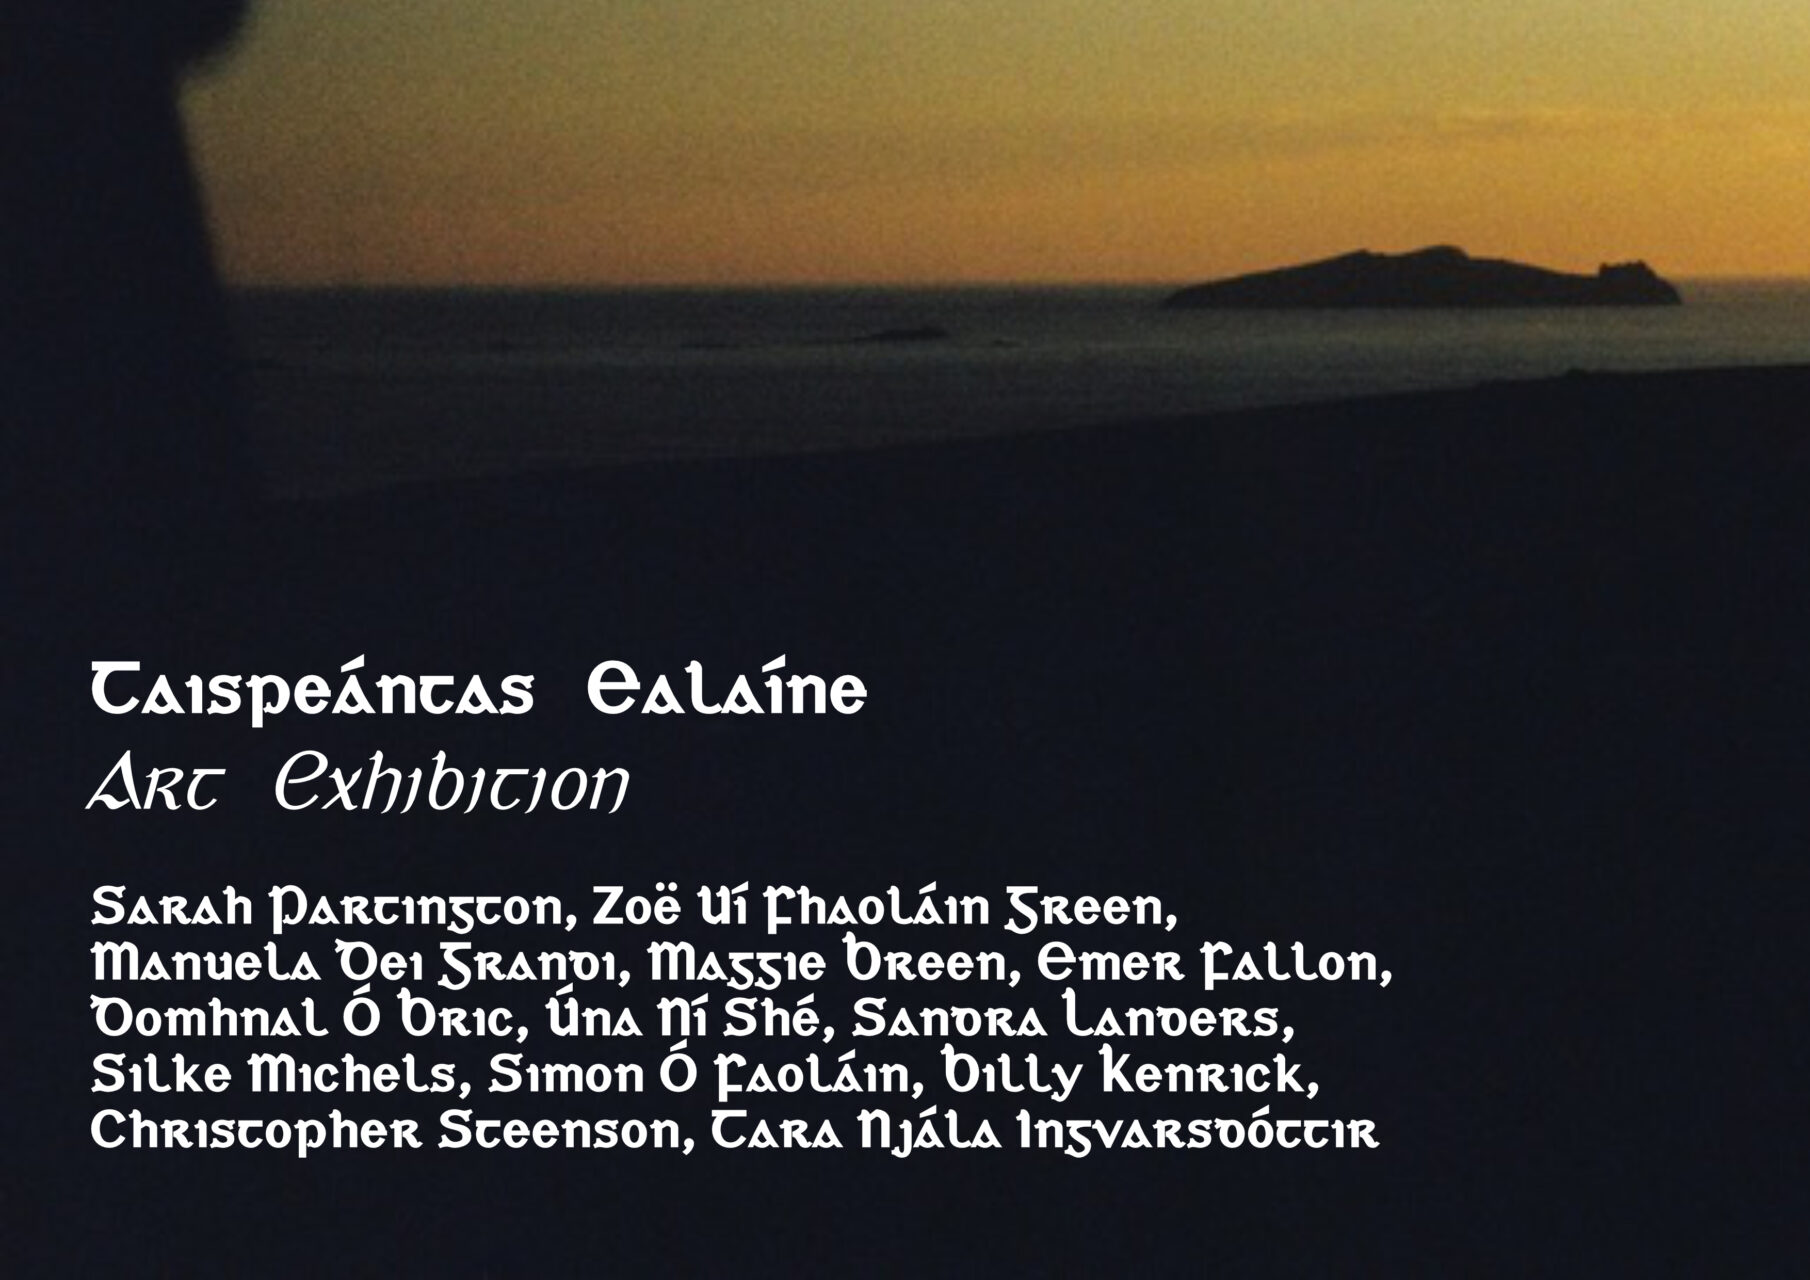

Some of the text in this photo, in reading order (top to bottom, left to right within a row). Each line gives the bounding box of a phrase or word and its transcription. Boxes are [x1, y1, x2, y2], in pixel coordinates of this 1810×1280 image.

[91, 654, 867, 728] Taispeántas Ealaíne
[85, 750, 630, 814] Art Exhibition
[91, 881, 1177, 935] Sarah Partington, Zoë Uí Fhaoláin Green,
[90, 931, 1392, 991] Manuela Dei Grandi, Maggie Breen, Emer Fallon,
[90, 983, 1294, 1044] Domhnal Ó Bric, Úna Ní Shé, Sandra Landers,
[91, 1038, 1319, 1102] Silke Michels, Simon Ó Faoláin, Billy Kenrick,
[91, 1104, 1380, 1158] Christopher Steenson, Tara Njála Ingvarsdóttir
